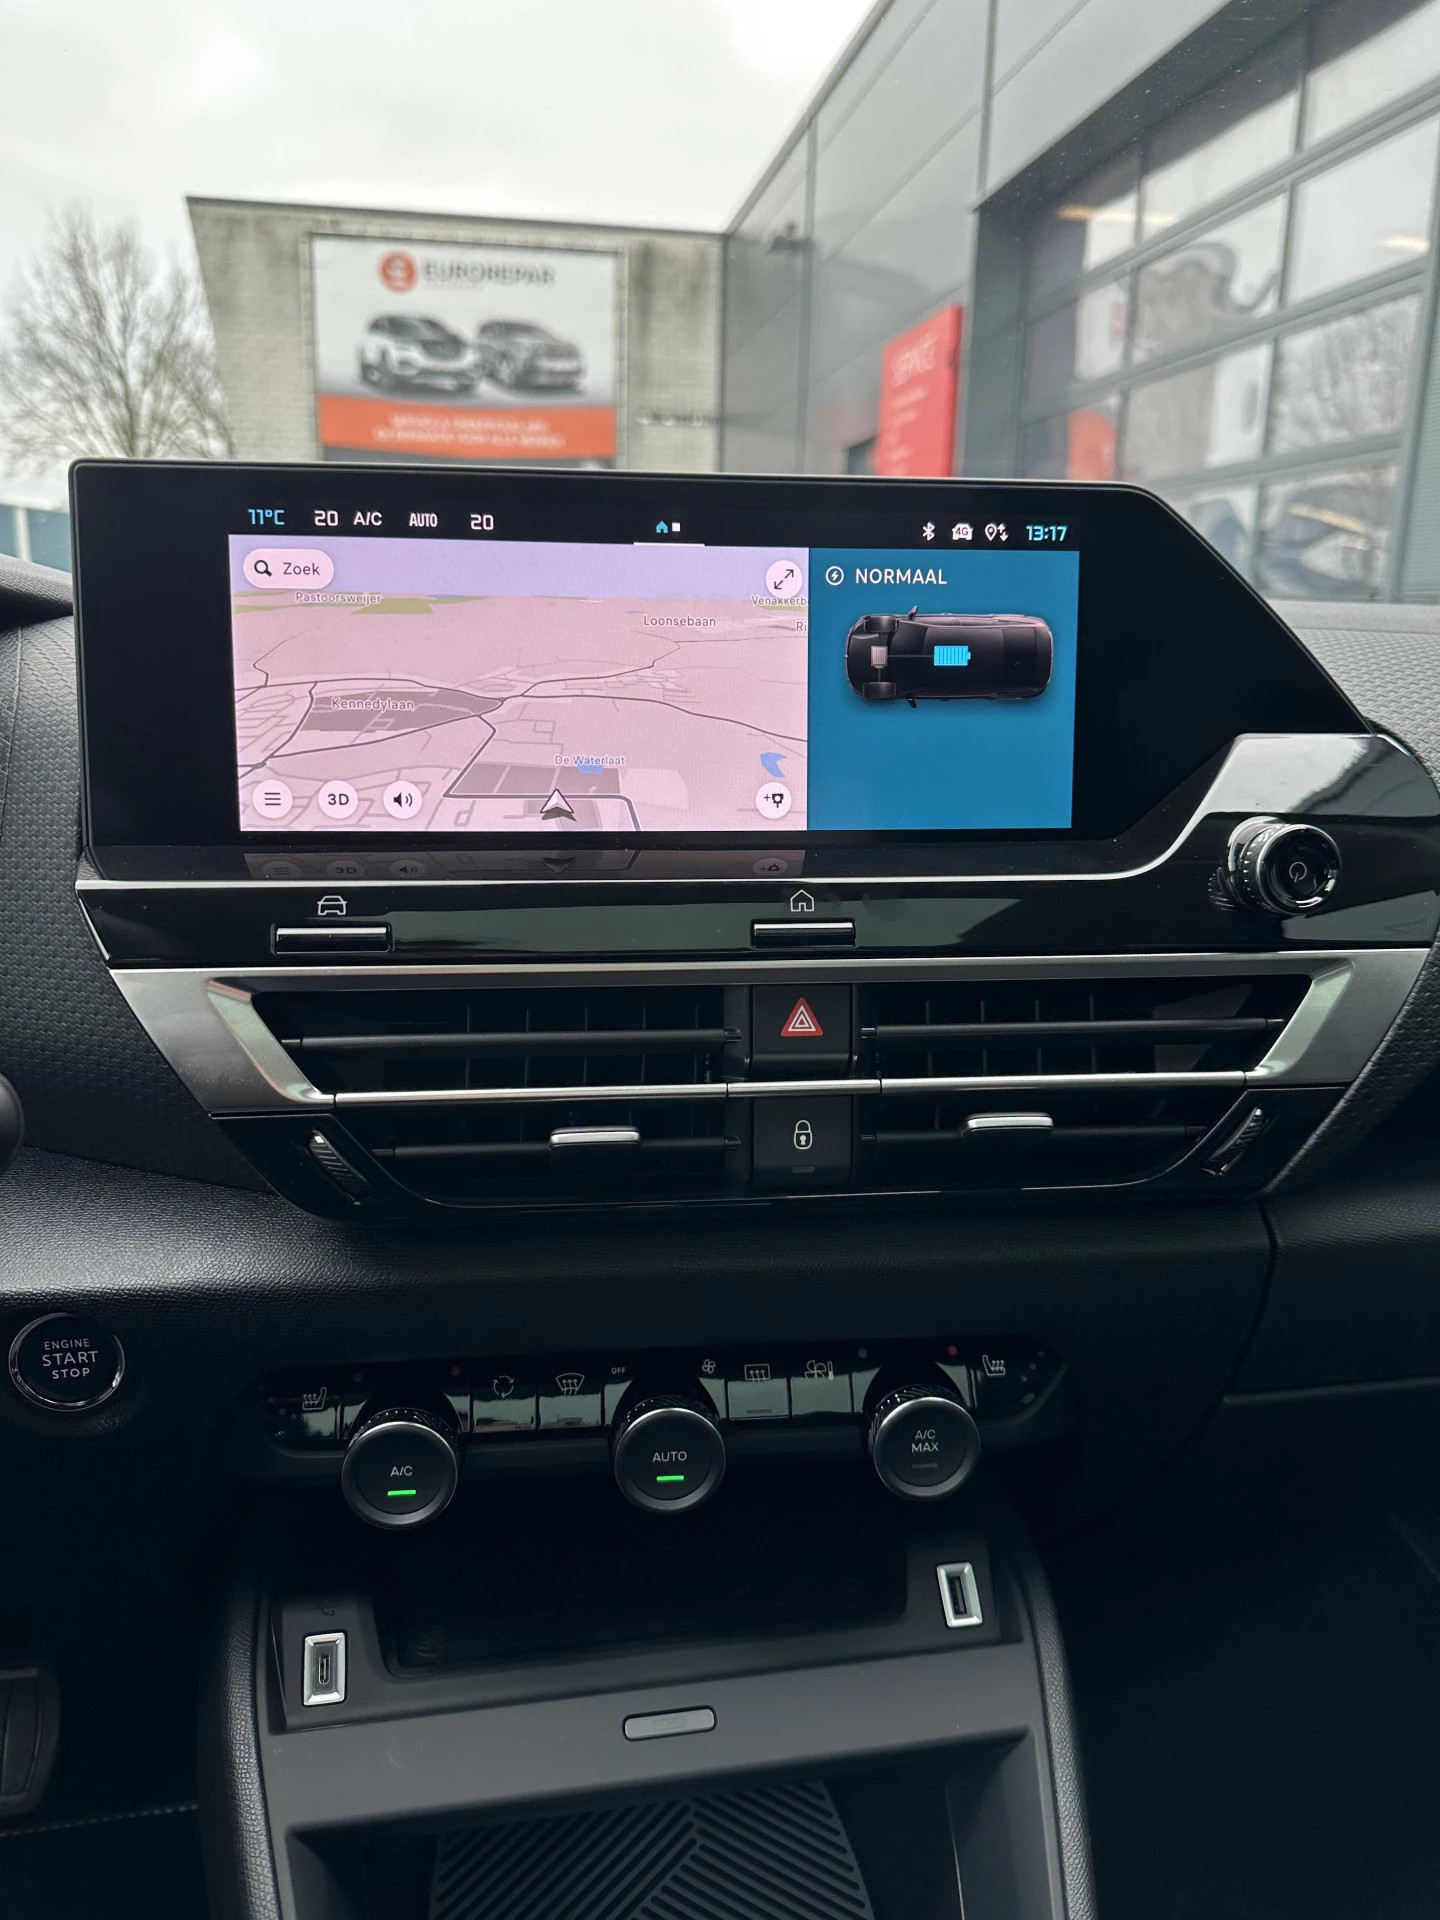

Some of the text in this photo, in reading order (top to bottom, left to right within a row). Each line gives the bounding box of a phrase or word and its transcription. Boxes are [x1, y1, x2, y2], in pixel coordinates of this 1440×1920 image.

[248, 508, 286, 526] 11°C
[314, 510, 494, 531] 20 A/C AUTO 20
[1025, 524, 1068, 542] 13:17
[282, 561, 321, 576] Zoek
[854, 567, 948, 586] NORMAAL
[295, 592, 381, 605] Pastoorsweijer
[643, 614, 717, 628] Loonsebaan
[331, 697, 415, 712] Kennedylaan
[555, 755, 625, 765] De Waterlaat
[327, 792, 350, 807] 3D
[44, 1338, 90, 1350] ENGINE
[41, 1350, 99, 1367] START
[52, 1367, 90, 1379] STOP
[610, 1366, 627, 1375] OFF
[915, 1429, 936, 1440] A/C
[911, 1441, 939, 1453] MAX
[652, 1450, 688, 1463] AUTO
[390, 1465, 413, 1478] A/C
